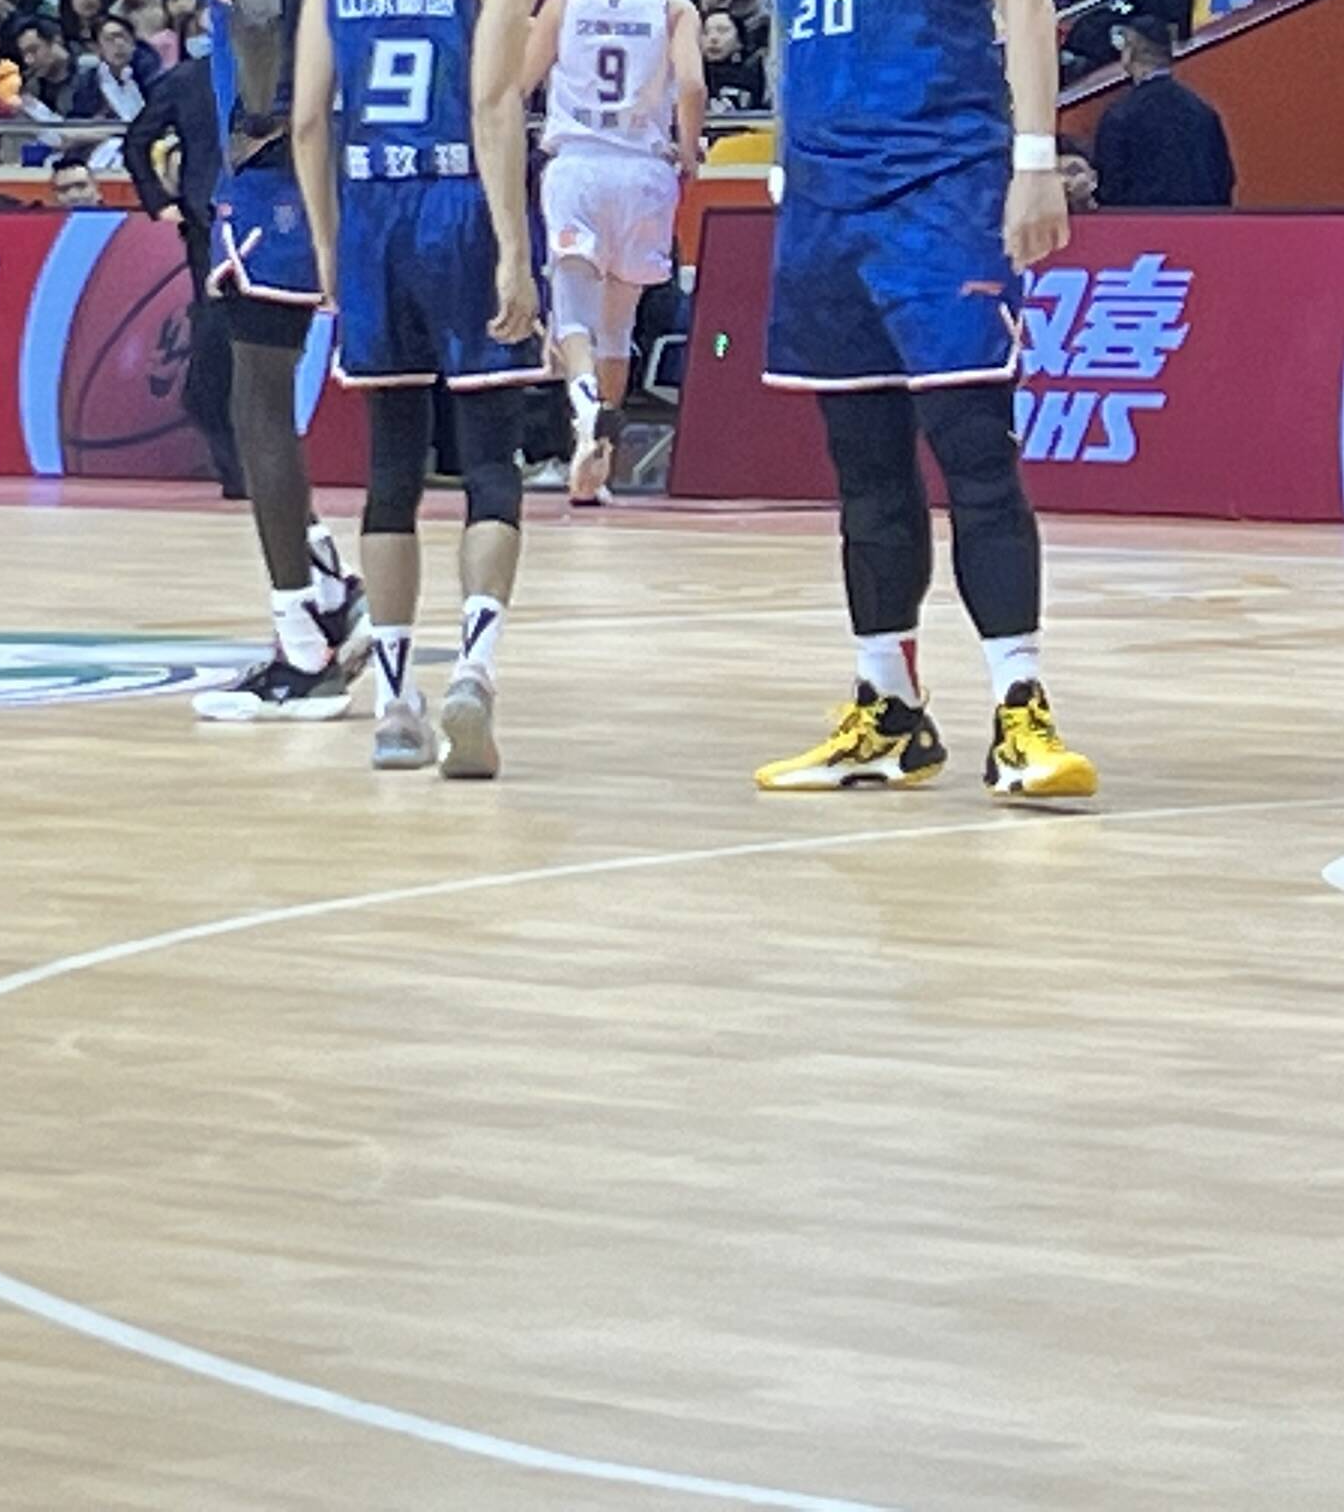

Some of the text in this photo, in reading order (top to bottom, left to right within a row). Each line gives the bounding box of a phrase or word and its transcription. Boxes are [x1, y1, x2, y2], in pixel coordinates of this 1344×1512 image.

[360, 38, 434, 125] 9
[597, 46, 626, 102] 9
[1021, 252, 1194, 378] 双喜
